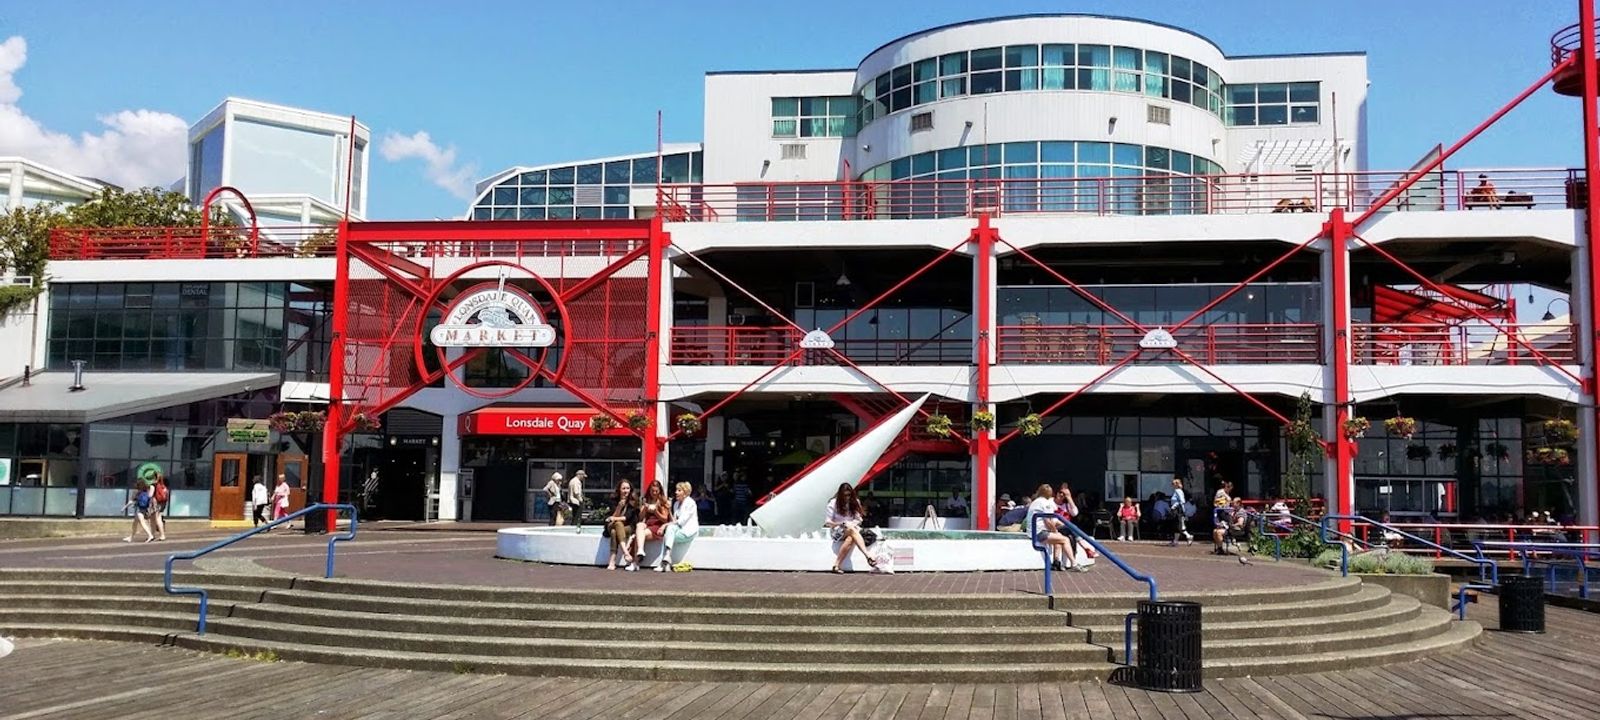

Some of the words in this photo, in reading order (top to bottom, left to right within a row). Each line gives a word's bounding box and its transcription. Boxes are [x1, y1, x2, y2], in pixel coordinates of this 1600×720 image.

[445, 330, 540, 341] MARKET
[464, 415, 472, 433] Q
[506, 416, 554, 428] Lonsdale
[557, 416, 586, 431] Quay
